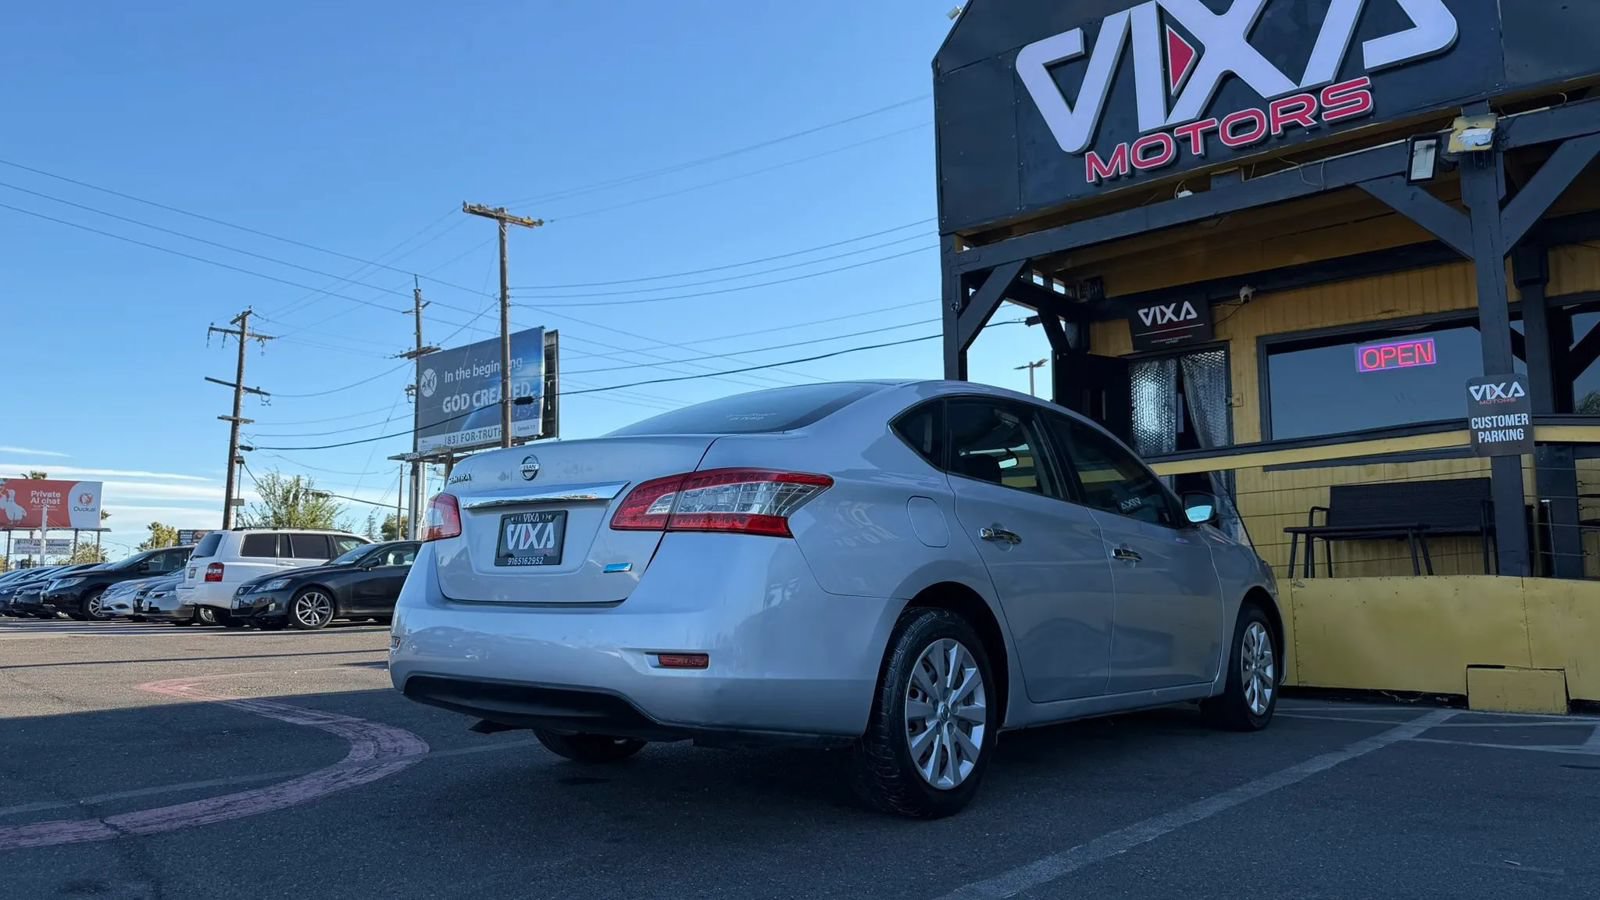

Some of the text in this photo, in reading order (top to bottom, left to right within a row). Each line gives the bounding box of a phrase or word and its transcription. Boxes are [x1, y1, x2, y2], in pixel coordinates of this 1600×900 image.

[1015, 0, 1459, 154] VIXA
[1085, 76, 1374, 183] MOTORS
[1137, 300, 1198, 327] VIXA
[1362, 341, 1433, 369] OPEN
[444, 357, 523, 384] In the beginng
[1469, 381, 1525, 401] VIXA
[442, 392, 470, 413] GOD
[1471, 413, 1529, 430] CUSTOMER
[1478, 428, 1525, 443] PARKING
[31, 490, 61, 498] Private
[41, 497, 61, 505] chat
[523, 512, 540, 523] VIXA
[506, 522, 555, 550] VIXA
